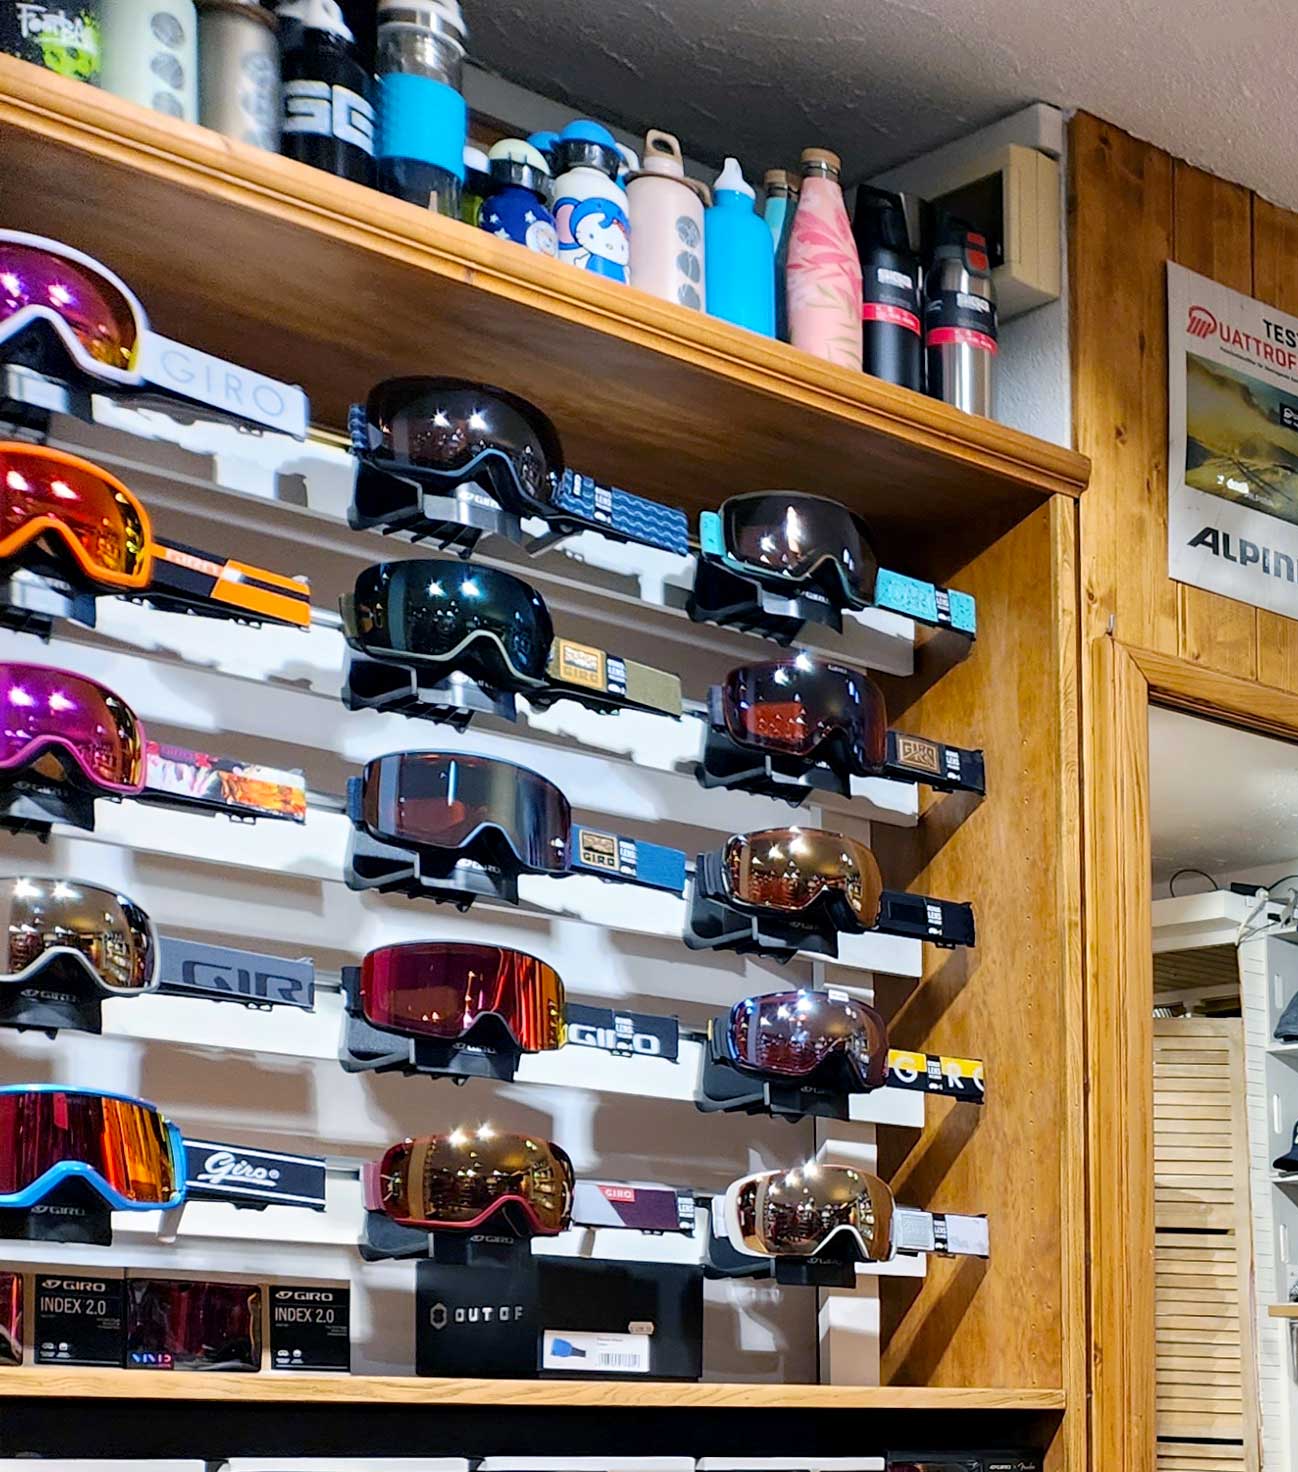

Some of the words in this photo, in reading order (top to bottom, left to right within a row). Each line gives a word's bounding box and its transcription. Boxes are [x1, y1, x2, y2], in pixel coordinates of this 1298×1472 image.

[161, 350, 286, 418] GIRO
[583, 852, 615, 867] GIRO
[605, 1188, 632, 1199] GIRO
[62, 1280, 106, 1292] GIRO
[294, 1291, 333, 1302] GIRO
[40, 1297, 82, 1314] INDEX
[85, 1300, 106, 1316] 2.0
[454, 1307, 492, 1322] OUT
[499, 1306, 524, 1321] OF
[275, 1307, 312, 1322] INDEX
[315, 1308, 335, 1323] 2.0
